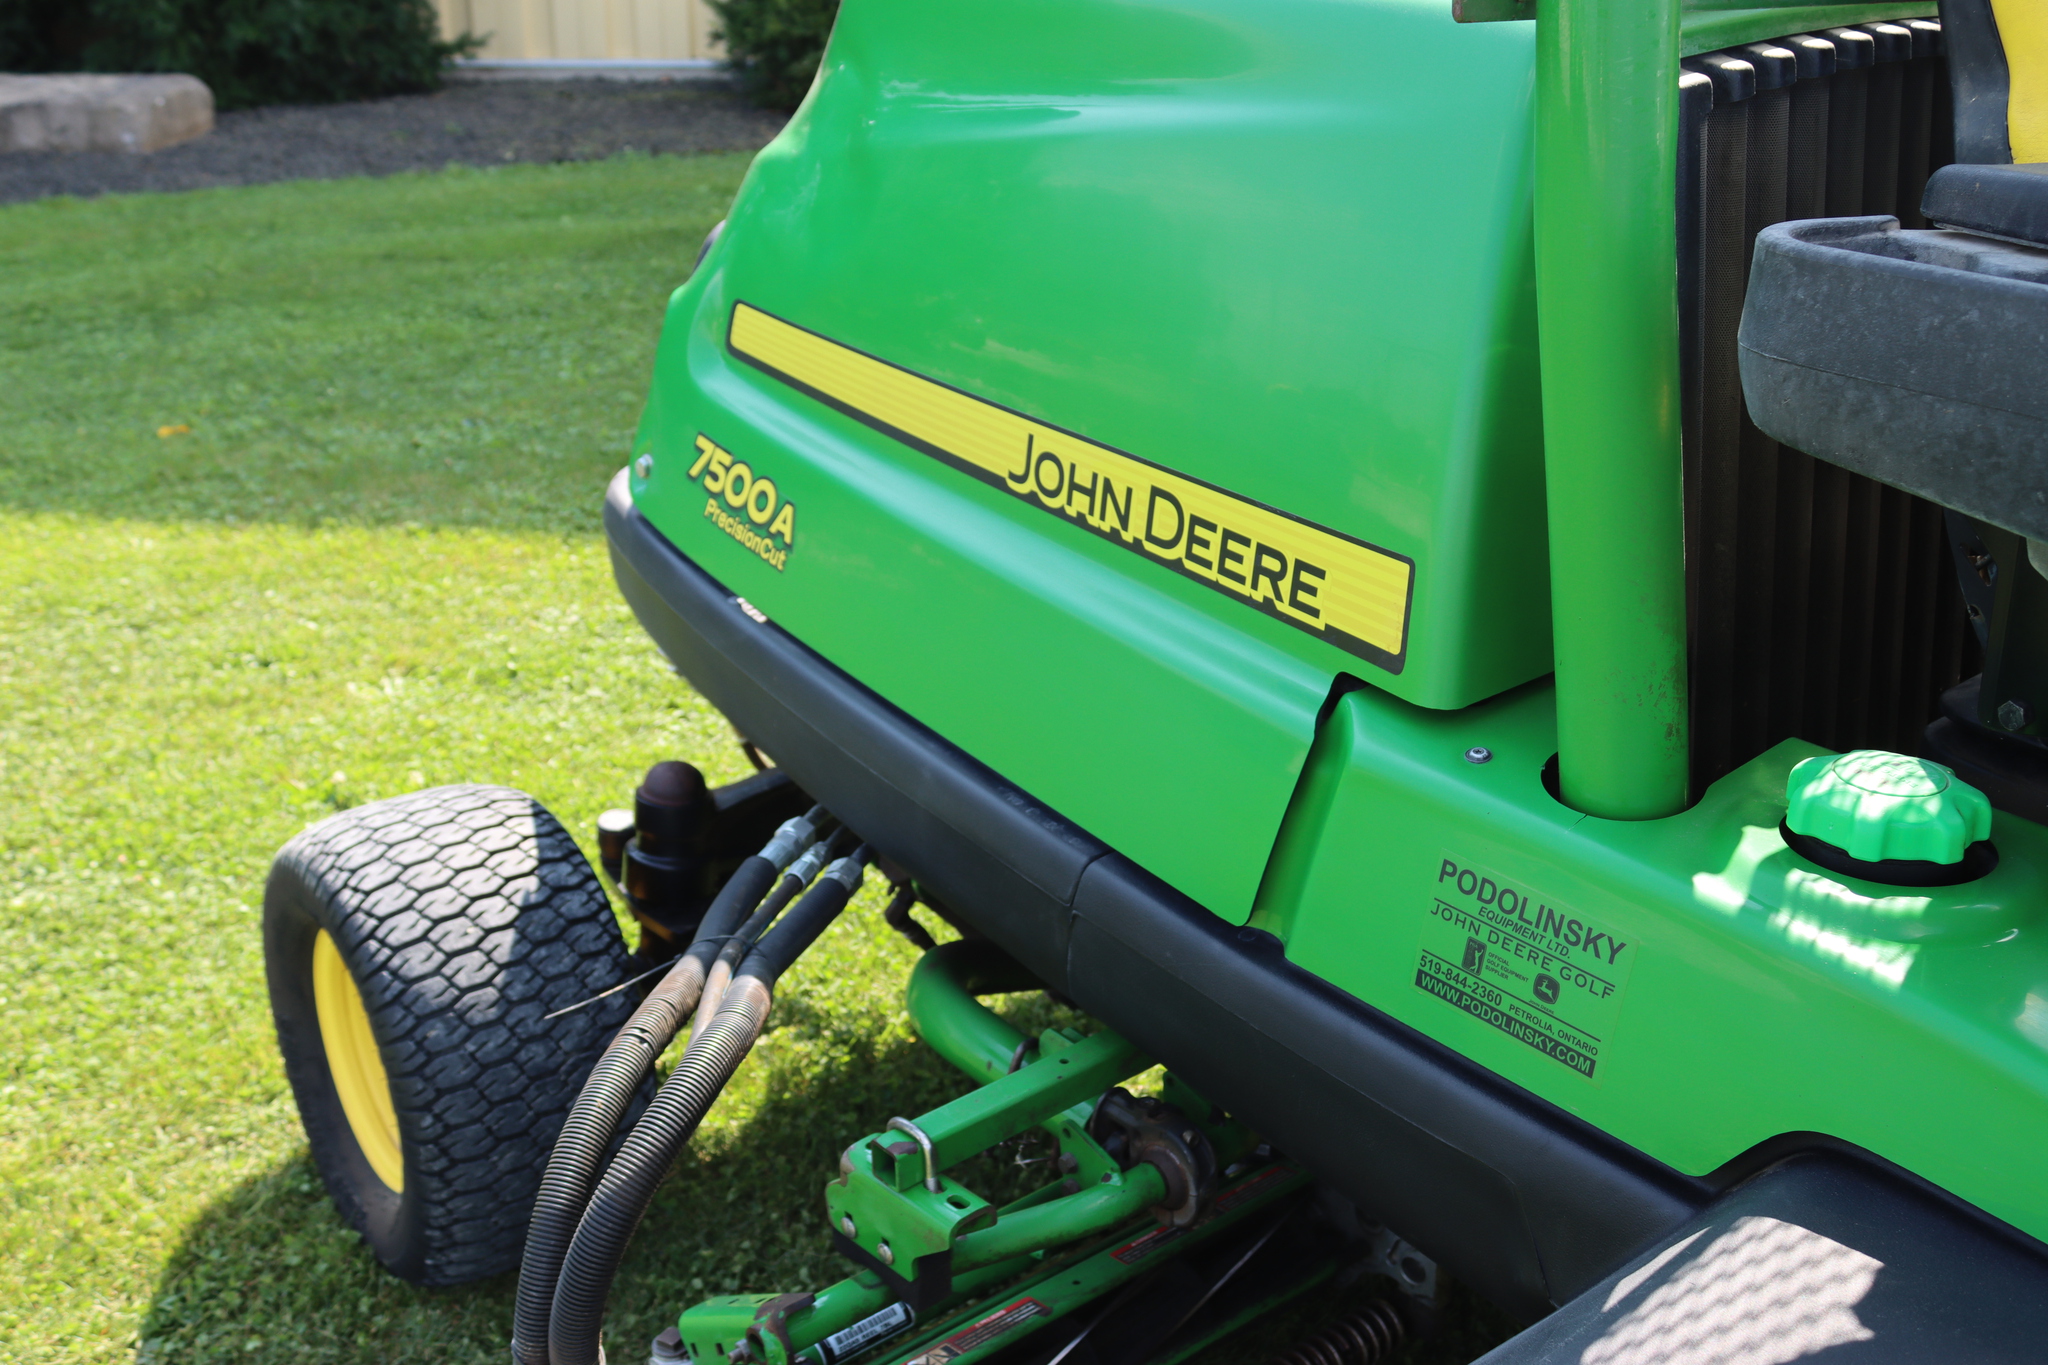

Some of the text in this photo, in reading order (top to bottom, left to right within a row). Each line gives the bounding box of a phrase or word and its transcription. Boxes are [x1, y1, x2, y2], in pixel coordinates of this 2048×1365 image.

[704, 497, 787, 572] PrecisionCut
[1008, 433, 1327, 620] JOHN DEERE
[1438, 859, 1626, 965] PODOLINSKY
[1478, 906, 1570, 959] EQUIPMENT LTD.
[1430, 903, 1615, 1000] JOHN DEERE GOLF
[1485, 965, 1509, 980] SUPPLIER
[1486, 958, 1529, 983] GOLF EQUIPMENT
[1488, 951, 1510, 966] OFFICIAL
[1419, 954, 1503, 1007] 519-844-2360
[1420, 972, 1592, 1075] WWW.PODOLINSKY.COM
[1508, 1003, 1599, 1056] PETROLIA, ONTARIO
